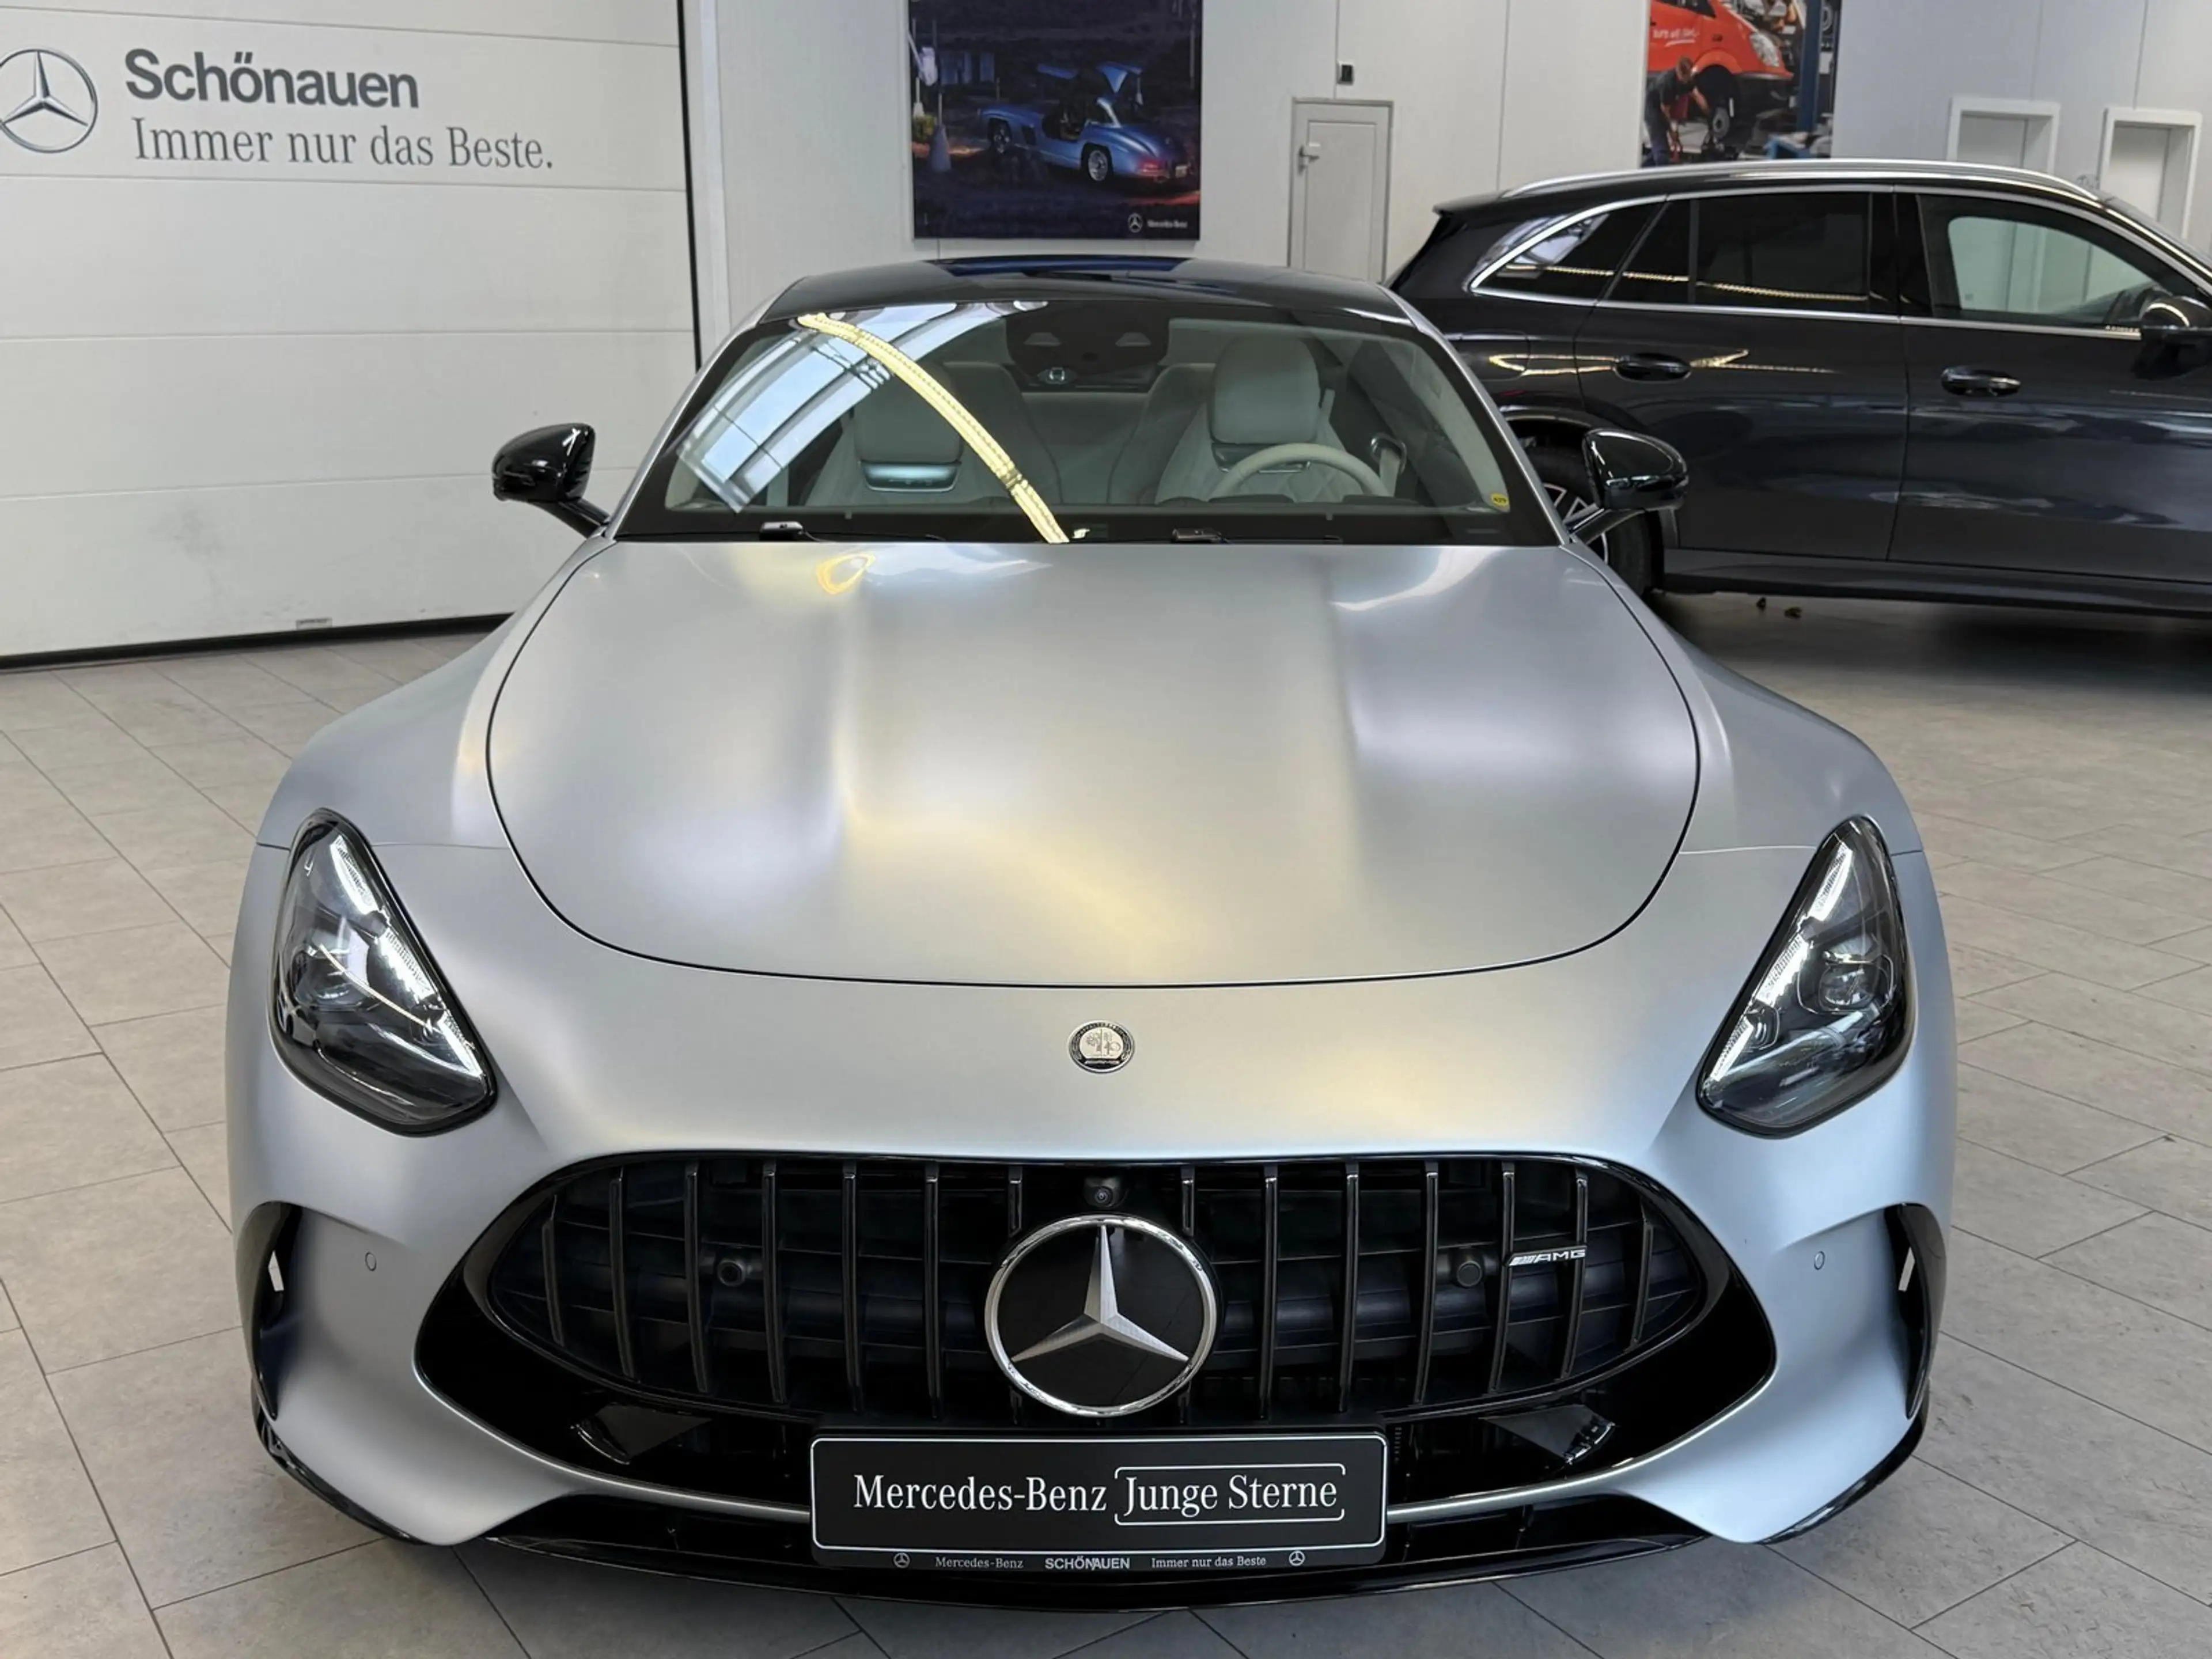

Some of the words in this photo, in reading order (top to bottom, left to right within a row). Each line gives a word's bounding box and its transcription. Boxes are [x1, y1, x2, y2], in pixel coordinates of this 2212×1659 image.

[125, 48, 419, 108] Schönauen
[134, 117, 273, 162] Immer
[287, 132, 357, 164] nur
[370, 124, 433, 165] das
[446, 127, 552, 169] Beste.
[1533, 1249, 1586, 1264] AMG
[854, 1474, 1107, 1511] Mercedes-Benz
[1123, 1476, 1218, 1518] Junge
[1228, 1474, 1337, 1509] Sterne
[935, 1556, 1024, 1569] Mercedes-Benz
[1044, 1556, 1131, 1571] SCHÖNAUEN
[1152, 1557, 1189, 1569] Immer
[1191, 1558, 1212, 1567] nur
[1214, 1556, 1234, 1567] das
[1237, 1555, 1267, 1566] Beste
